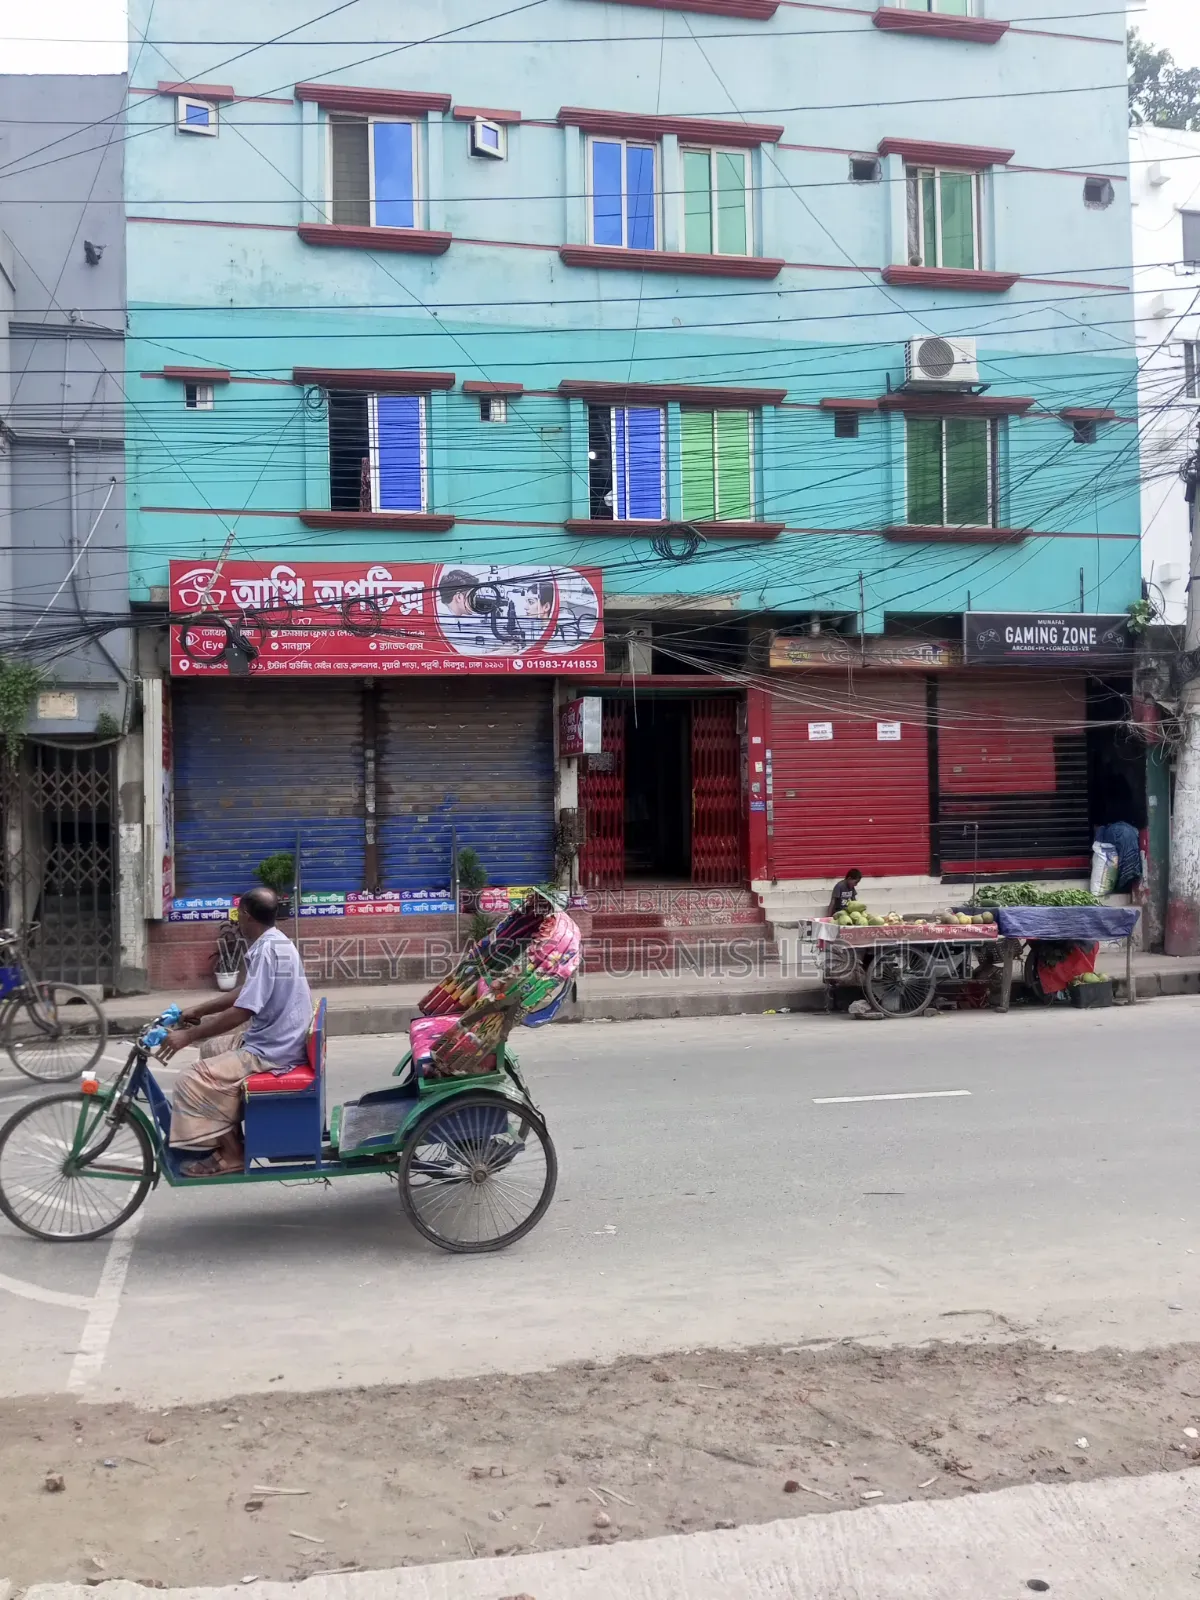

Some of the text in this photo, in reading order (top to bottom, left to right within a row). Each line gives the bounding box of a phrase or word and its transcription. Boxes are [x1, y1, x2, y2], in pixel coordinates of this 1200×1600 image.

[1005, 626, 1097, 644] GAMING ZONE
[527, 660, 598, 669] 01983-741853
